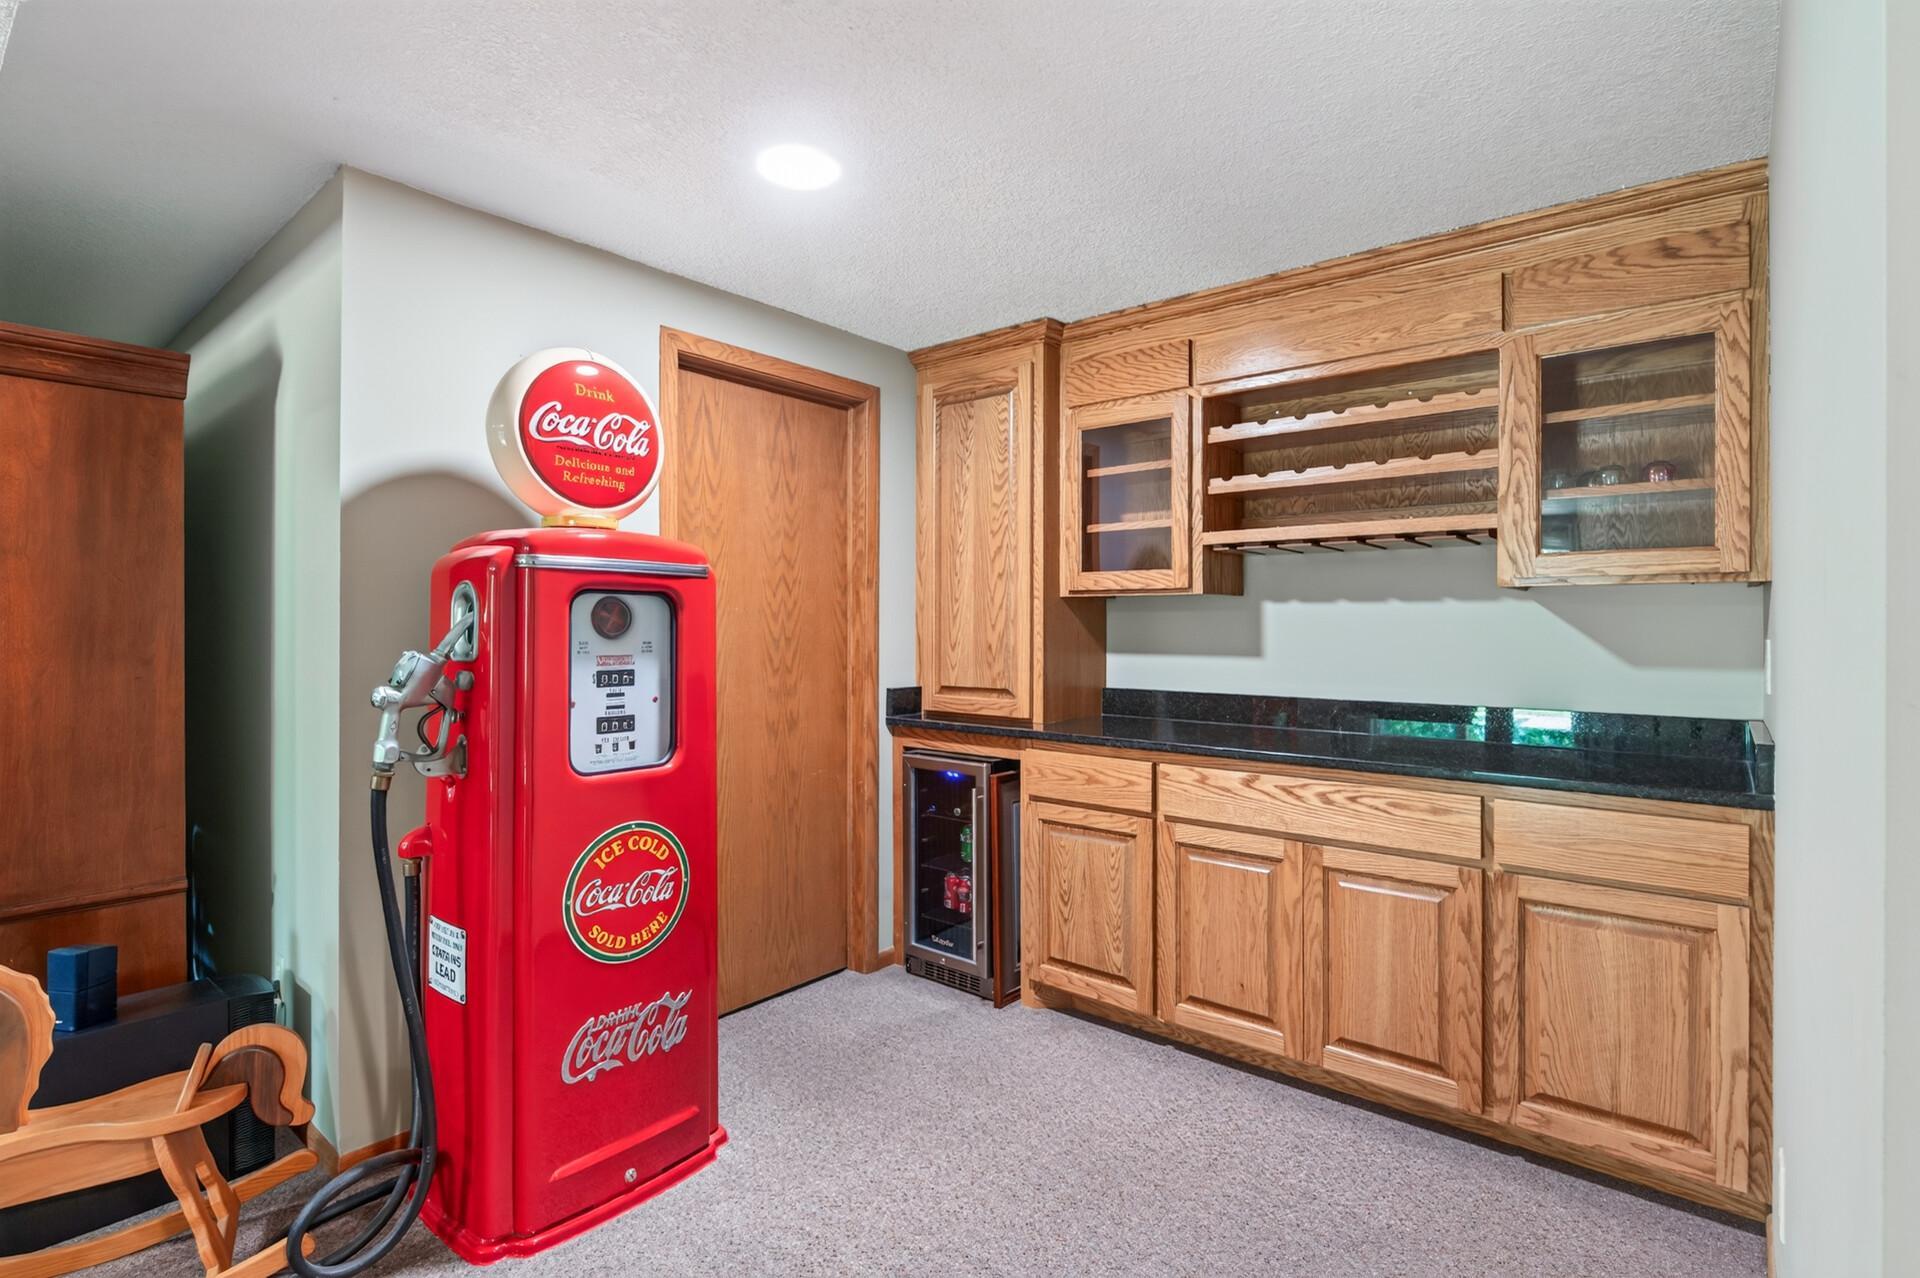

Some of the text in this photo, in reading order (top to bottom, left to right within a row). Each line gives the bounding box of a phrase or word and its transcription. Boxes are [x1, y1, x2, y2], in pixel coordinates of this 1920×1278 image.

[575, 383, 614, 402] Drink
[528, 400, 651, 458] Coca-Cola
[554, 455, 635, 476] Delicious and
[563, 471, 626, 492] Refreshing
[593, 835, 670, 870] ICE COLD
[575, 866, 679, 917] Coca-Cola
[588, 911, 668, 949] SOLD HERE
[435, 961, 456, 983] LEAD
